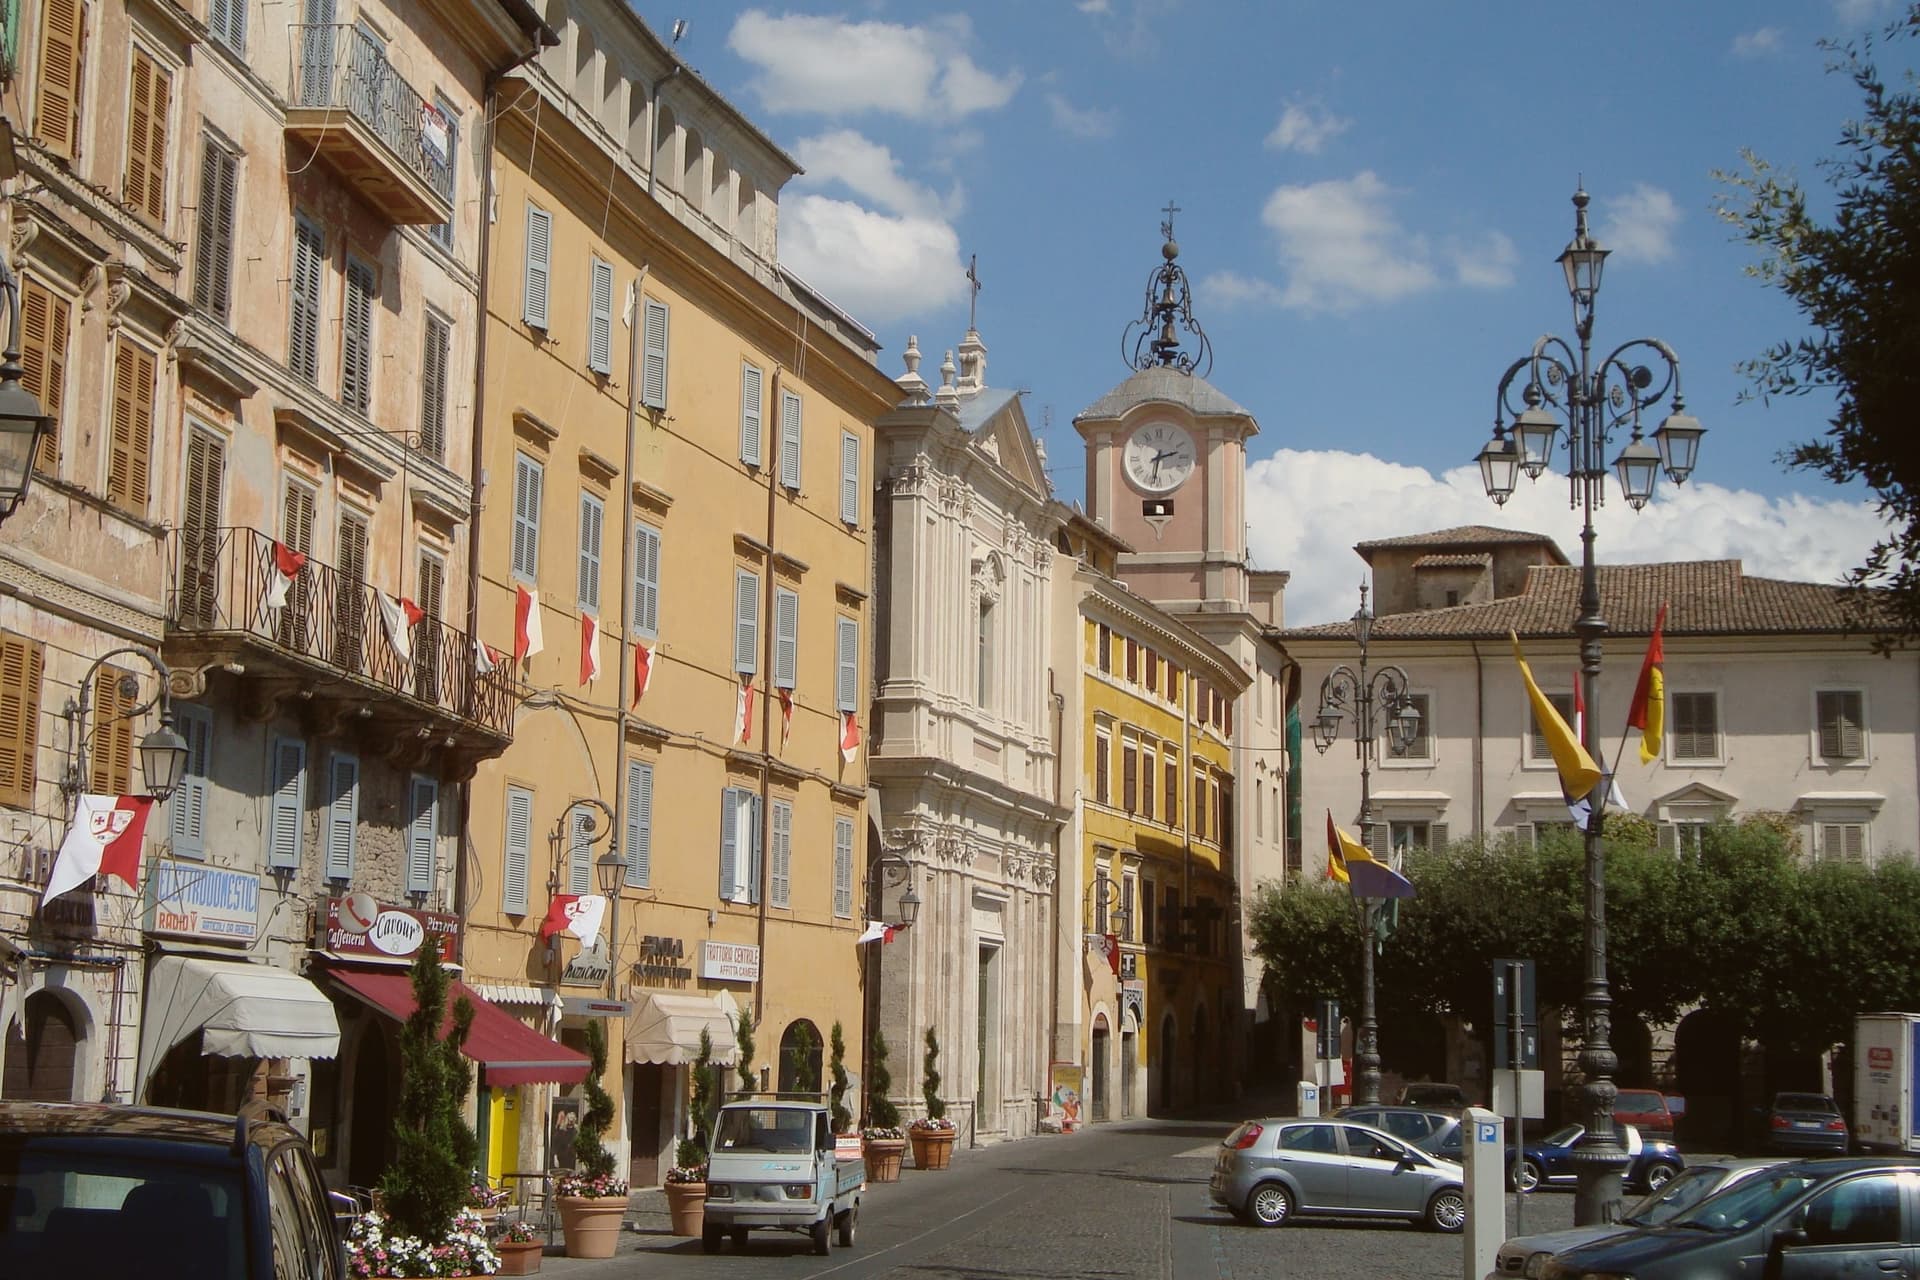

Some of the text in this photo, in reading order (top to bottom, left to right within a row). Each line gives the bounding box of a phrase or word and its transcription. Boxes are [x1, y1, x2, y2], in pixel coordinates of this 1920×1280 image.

[159, 912, 189, 931] RADIO
[427, 916, 458, 934] Pizzeria
[706, 944, 758, 965] TRATTORIA CENTRALE
[1482, 1125, 1495, 1140] P
